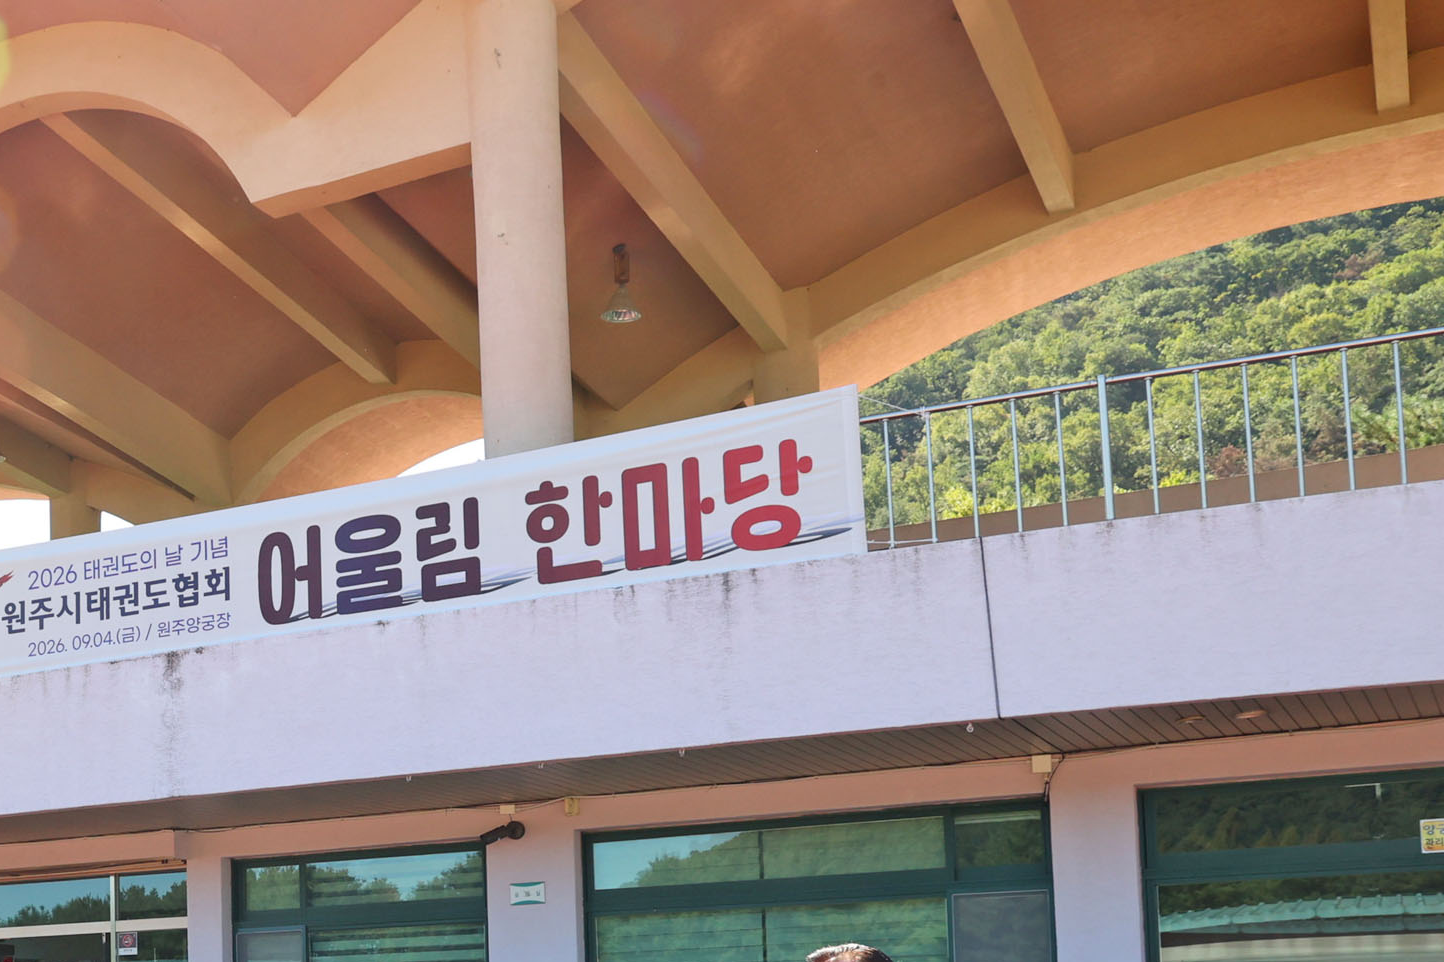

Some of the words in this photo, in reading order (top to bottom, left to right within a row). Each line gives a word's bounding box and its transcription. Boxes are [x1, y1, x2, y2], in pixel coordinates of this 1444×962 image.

[257, 496, 482, 625] 어울림
[525, 438, 815, 585] 한마당
[27, 564, 78, 590] 2026
[83, 548, 157, 581] 태권도의
[164, 544, 183, 567] 날
[190, 536, 229, 562] 기념
[1, 566, 231, 635] 원주시태권도협회
[27, 638, 68, 657] 2026.
[72, 626, 141, 651] 09.04.(금)
[144, 623, 153, 641] /
[157, 611, 232, 638] 원주양궁장
